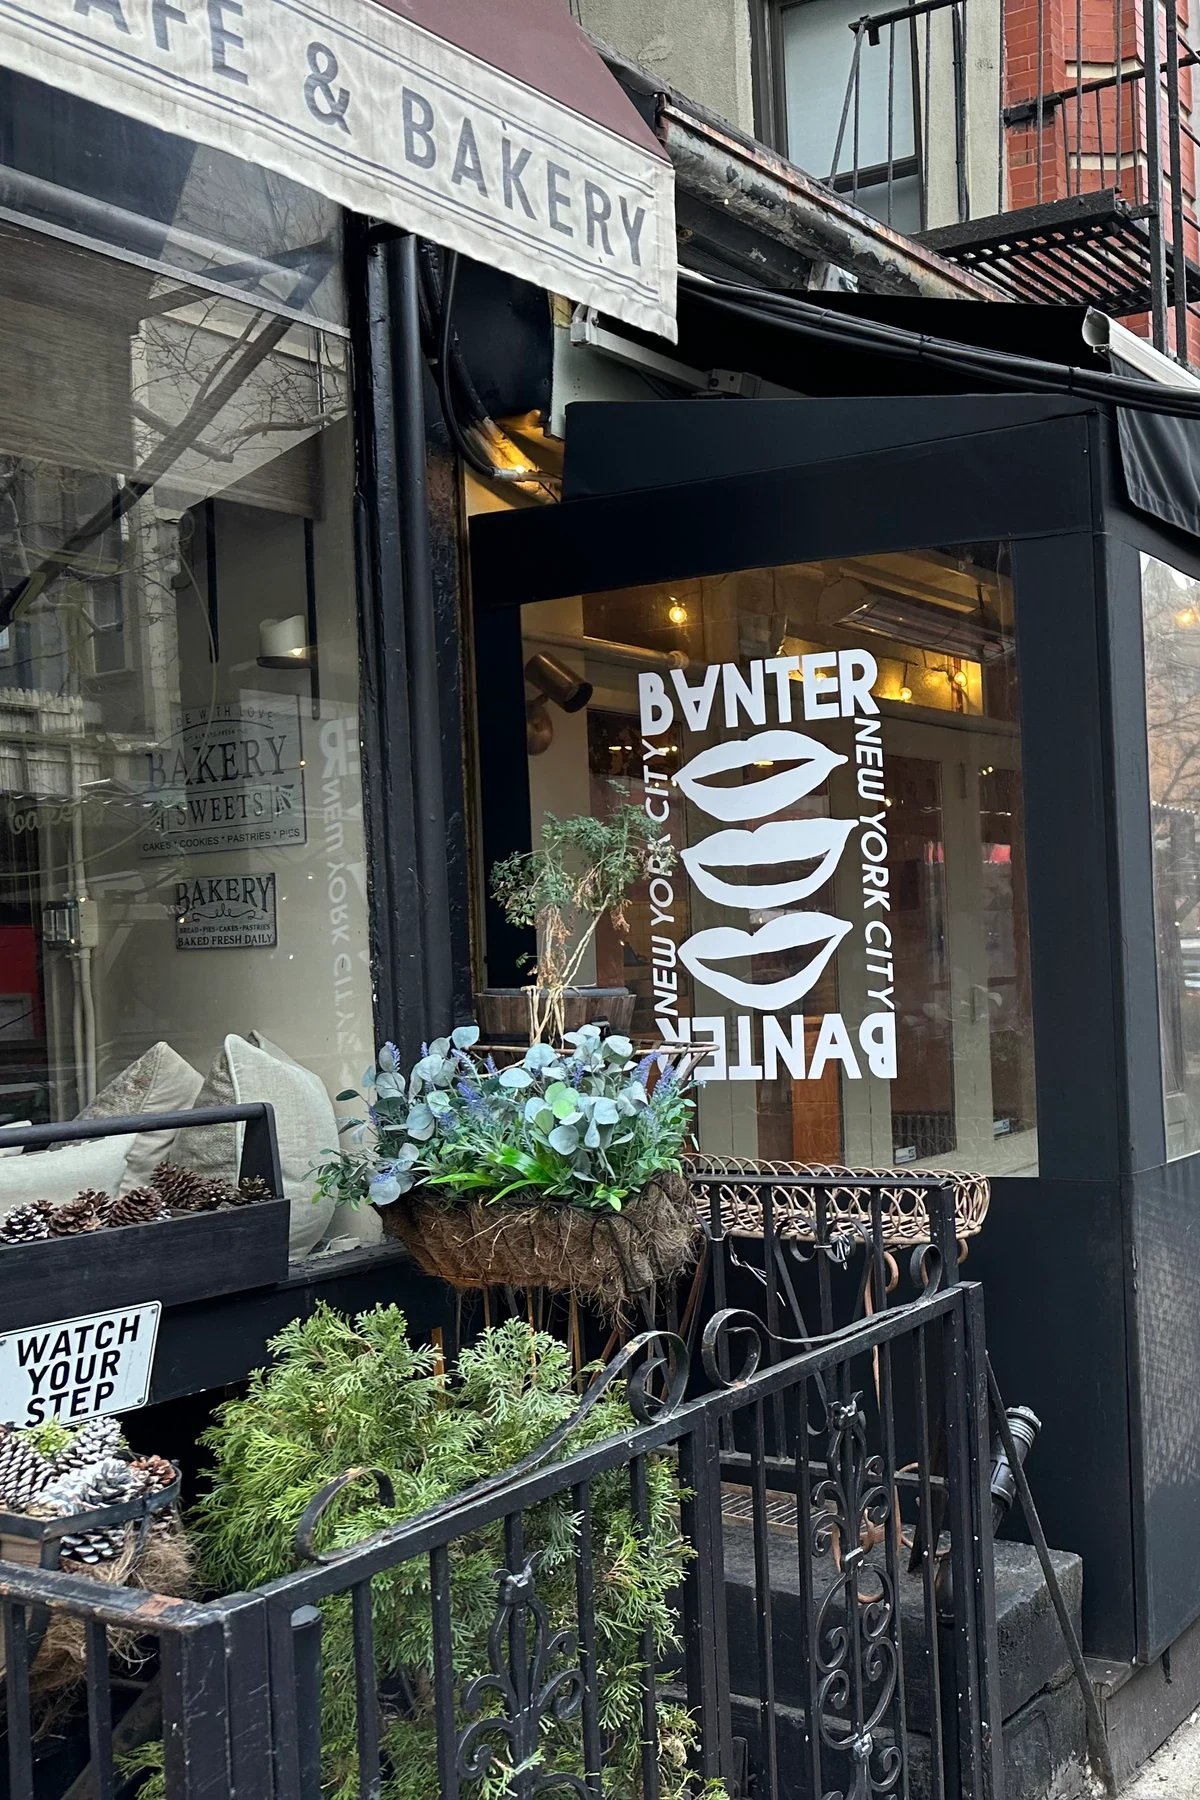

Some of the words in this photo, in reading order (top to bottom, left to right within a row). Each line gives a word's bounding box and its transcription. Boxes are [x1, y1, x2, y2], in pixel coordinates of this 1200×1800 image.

[304, 41, 352, 136] &
[402, 85, 646, 267] BAKERY
[200, 706, 231, 720] WTH
[240, 706, 274, 722] LOVE
[638, 648, 880, 736] BANTER
[145, 735, 287, 791] BAKERY
[642, 739, 670, 823] CITY
[854, 717, 886, 802] NEW
[176, 792, 264, 826] SWEETS
[143, 841, 172, 852] CAKES
[180, 837, 220, 848] COOKIES
[227, 831, 271, 843] PASTRIES
[280, 828, 300, 838] PIES
[859, 811, 891, 912] YORK
[174, 877, 272, 920] BAKERY
[648, 833, 675, 926] YORK
[178, 936, 209, 947] BAKED
[212, 935, 242, 945] FRESH
[245, 934, 273, 944] DAILY
[865, 919, 896, 1011] CITY
[651, 935, 678, 1017] NEW
[17, 1314, 141, 1367] WATCH
[28, 1350, 121, 1396] YOUR
[25, 1382, 114, 1428] STEP
